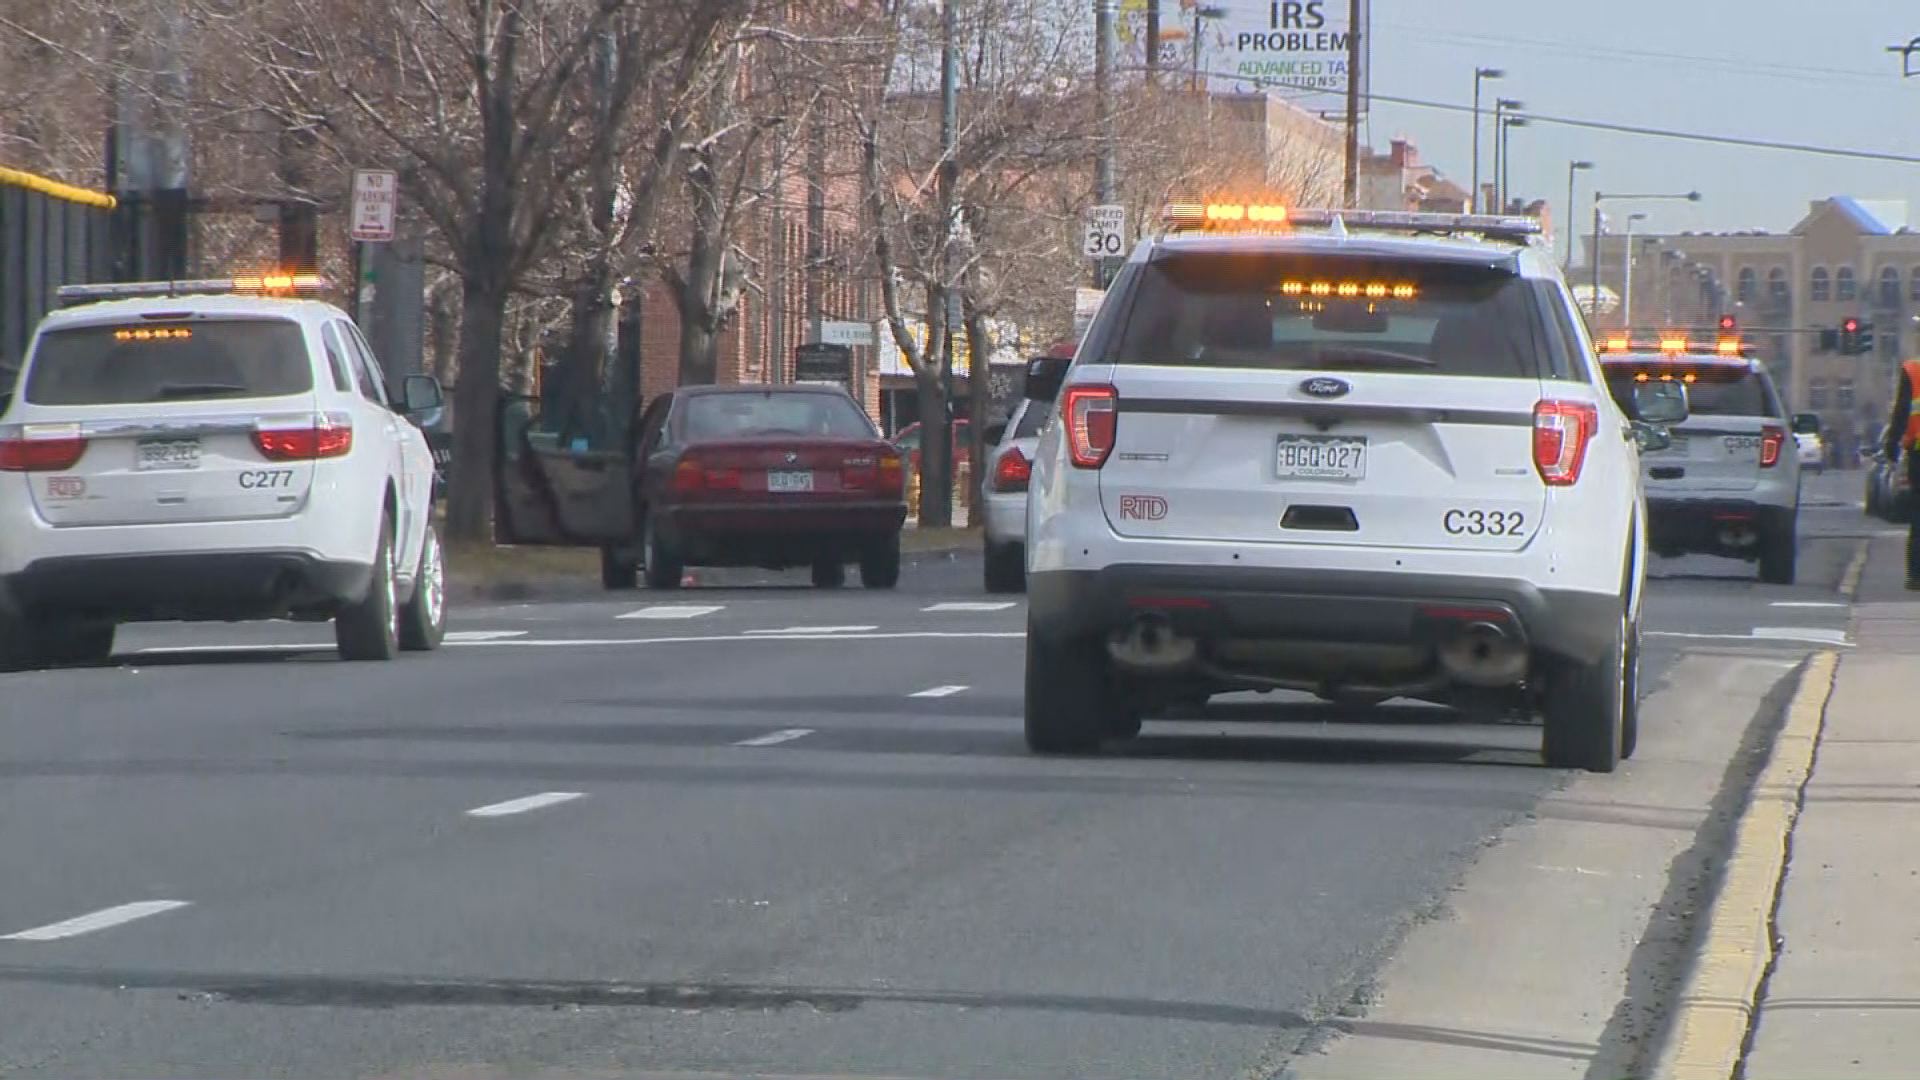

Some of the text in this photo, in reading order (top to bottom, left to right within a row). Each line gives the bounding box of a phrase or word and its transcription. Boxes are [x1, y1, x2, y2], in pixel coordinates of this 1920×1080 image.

[1270, 1, 1325, 29] IRS
[1238, 32, 1361, 51] PROBLEM
[1237, 61, 1321, 75] ADVANCED
[367, 174, 385, 188] NO
[1088, 231, 1121, 254] 30
[47, 475, 86, 496] RTD
[239, 470, 294, 489] C277
[1120, 494, 1168, 520] RTD
[1443, 509, 1524, 536] C332
